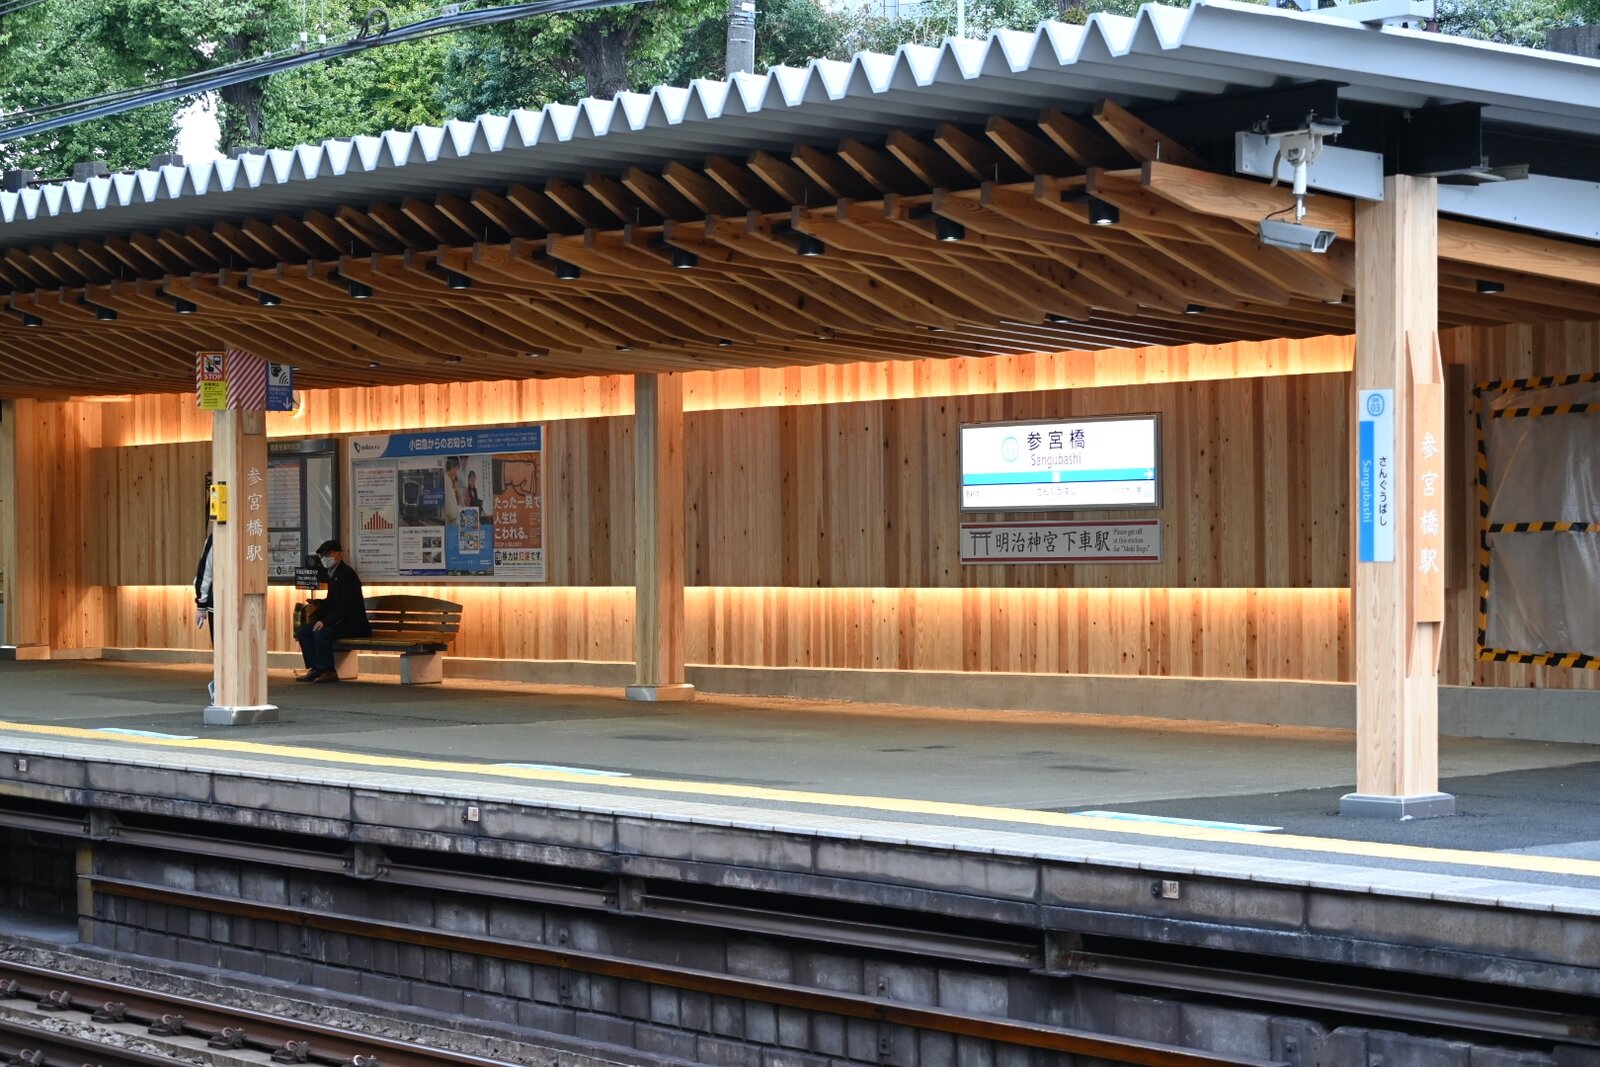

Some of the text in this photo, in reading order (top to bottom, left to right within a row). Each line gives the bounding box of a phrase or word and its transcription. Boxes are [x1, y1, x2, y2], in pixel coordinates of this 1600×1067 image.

[1370, 404, 1381, 413] 03
[408, 436, 473, 452] 小田急からのお知らせ
[1027, 428, 1086, 451] 参宮橋
[1031, 452, 1082, 468] Sangubashi
[1361, 460, 1372, 523] Sangubashi
[1378, 456, 1388, 527] さんぐうばし
[494, 495, 541, 509] たった一発で
[1419, 432, 1439, 573] 参宮橋駅
[245, 467, 264, 563] 参宮橋駅
[494, 511, 518, 524] 人生は
[495, 527, 528, 540] こわれる。
